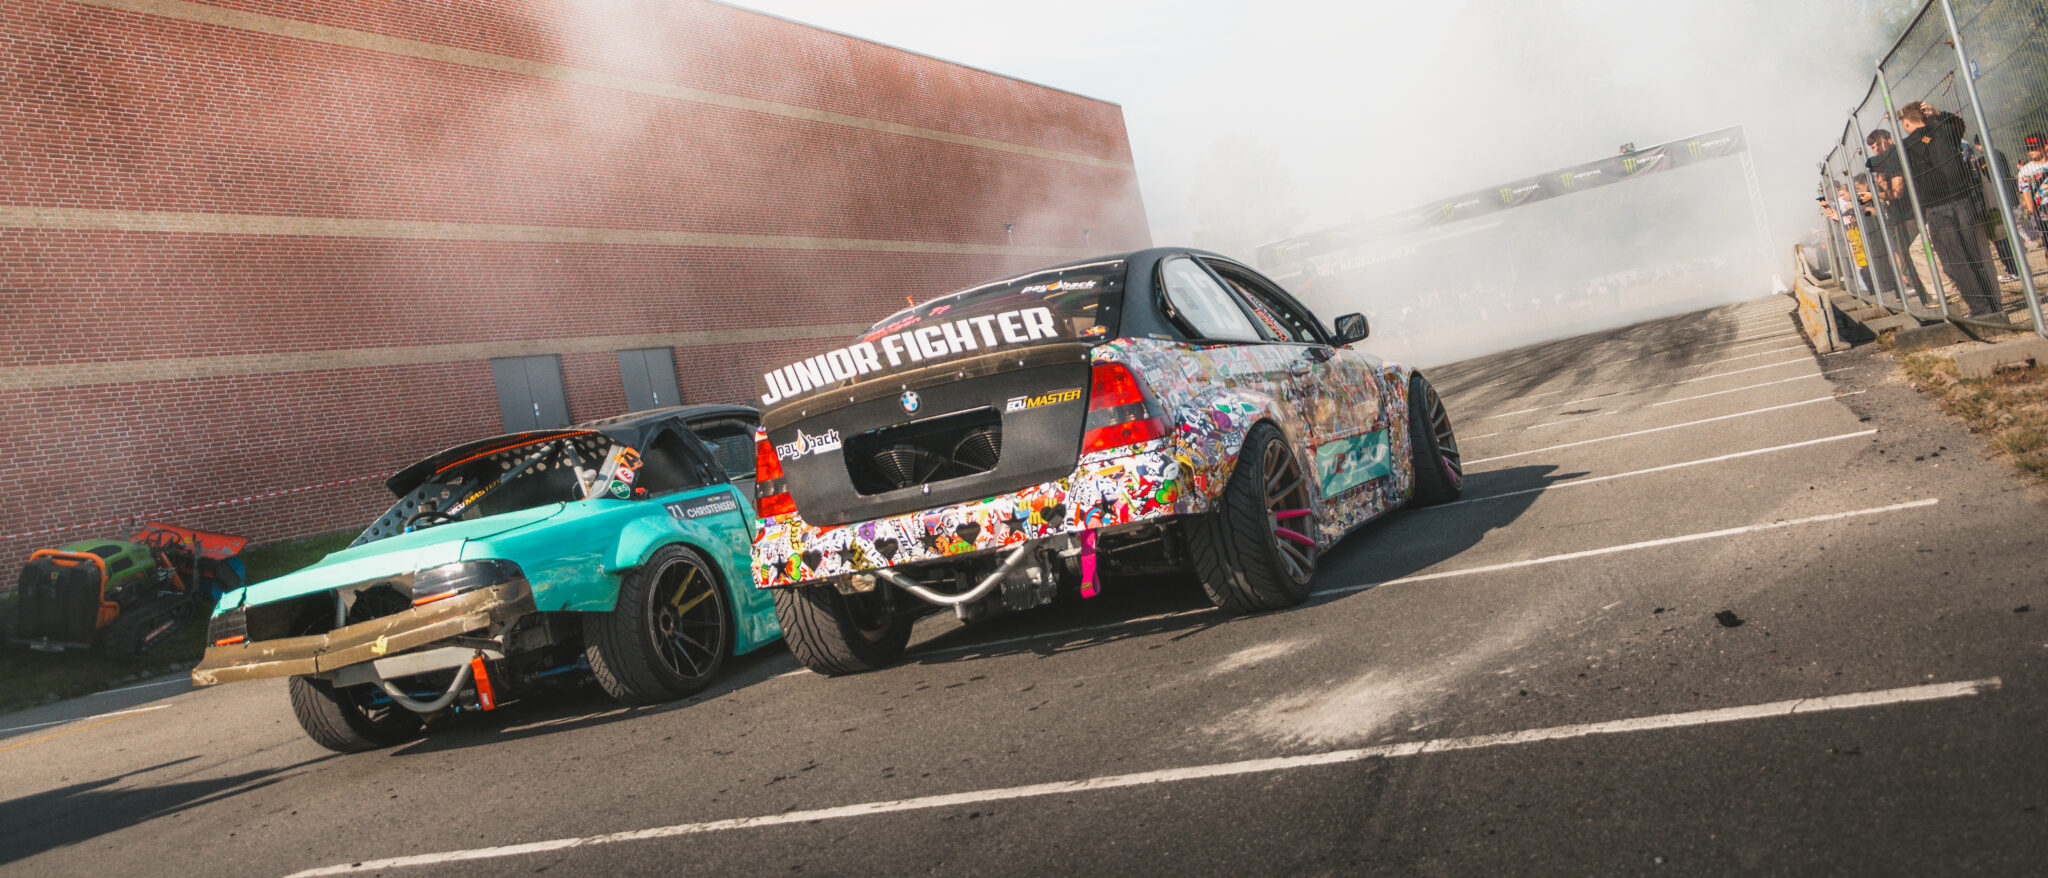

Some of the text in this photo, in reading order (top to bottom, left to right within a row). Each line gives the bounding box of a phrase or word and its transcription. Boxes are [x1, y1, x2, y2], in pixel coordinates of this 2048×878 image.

[761, 342, 883, 406] JUNIOR
[881, 306, 1060, 367] FIGHTER
[667, 500, 737, 518] 71 CHRISTENSEN
